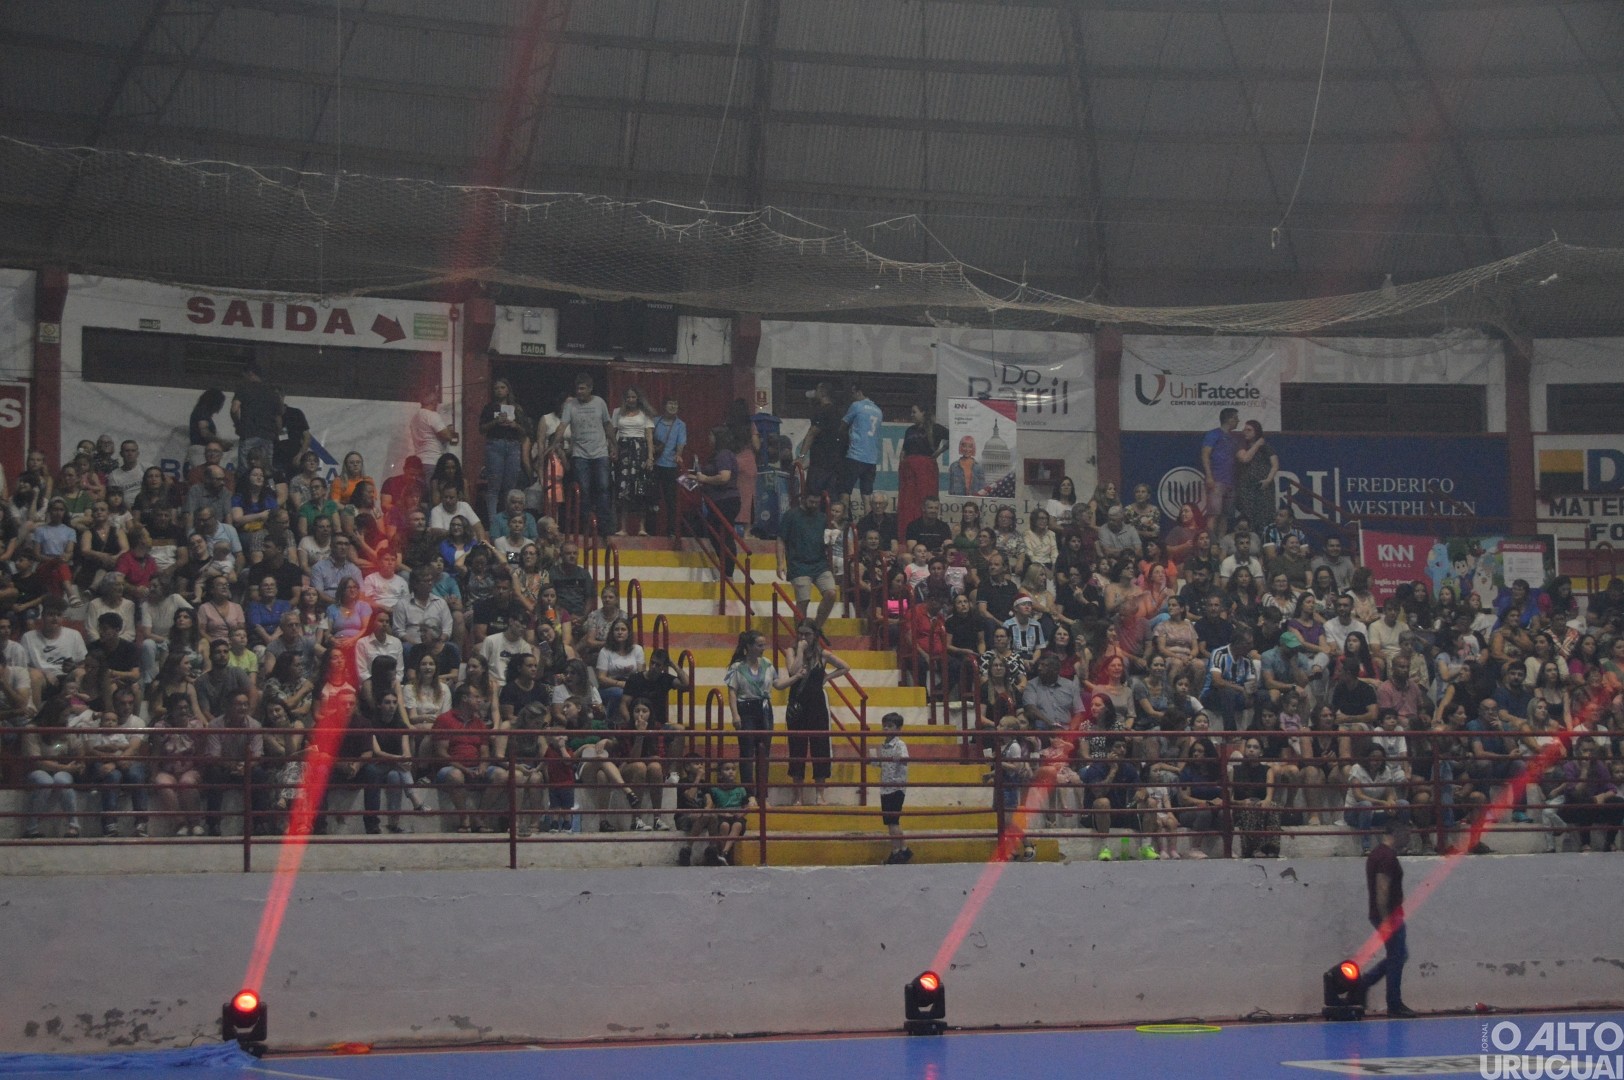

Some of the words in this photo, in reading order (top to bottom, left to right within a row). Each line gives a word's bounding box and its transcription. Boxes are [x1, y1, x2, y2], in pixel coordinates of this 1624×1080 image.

[186, 296, 356, 336] SAIDA
[521, 343, 545, 354] SAÍDA
[1002, 364, 1041, 385] Do
[1169, 382, 1260, 400] UniFatecie
[1346, 477, 1455, 494] FREDERICO
[1377, 544, 1414, 562] KNN
